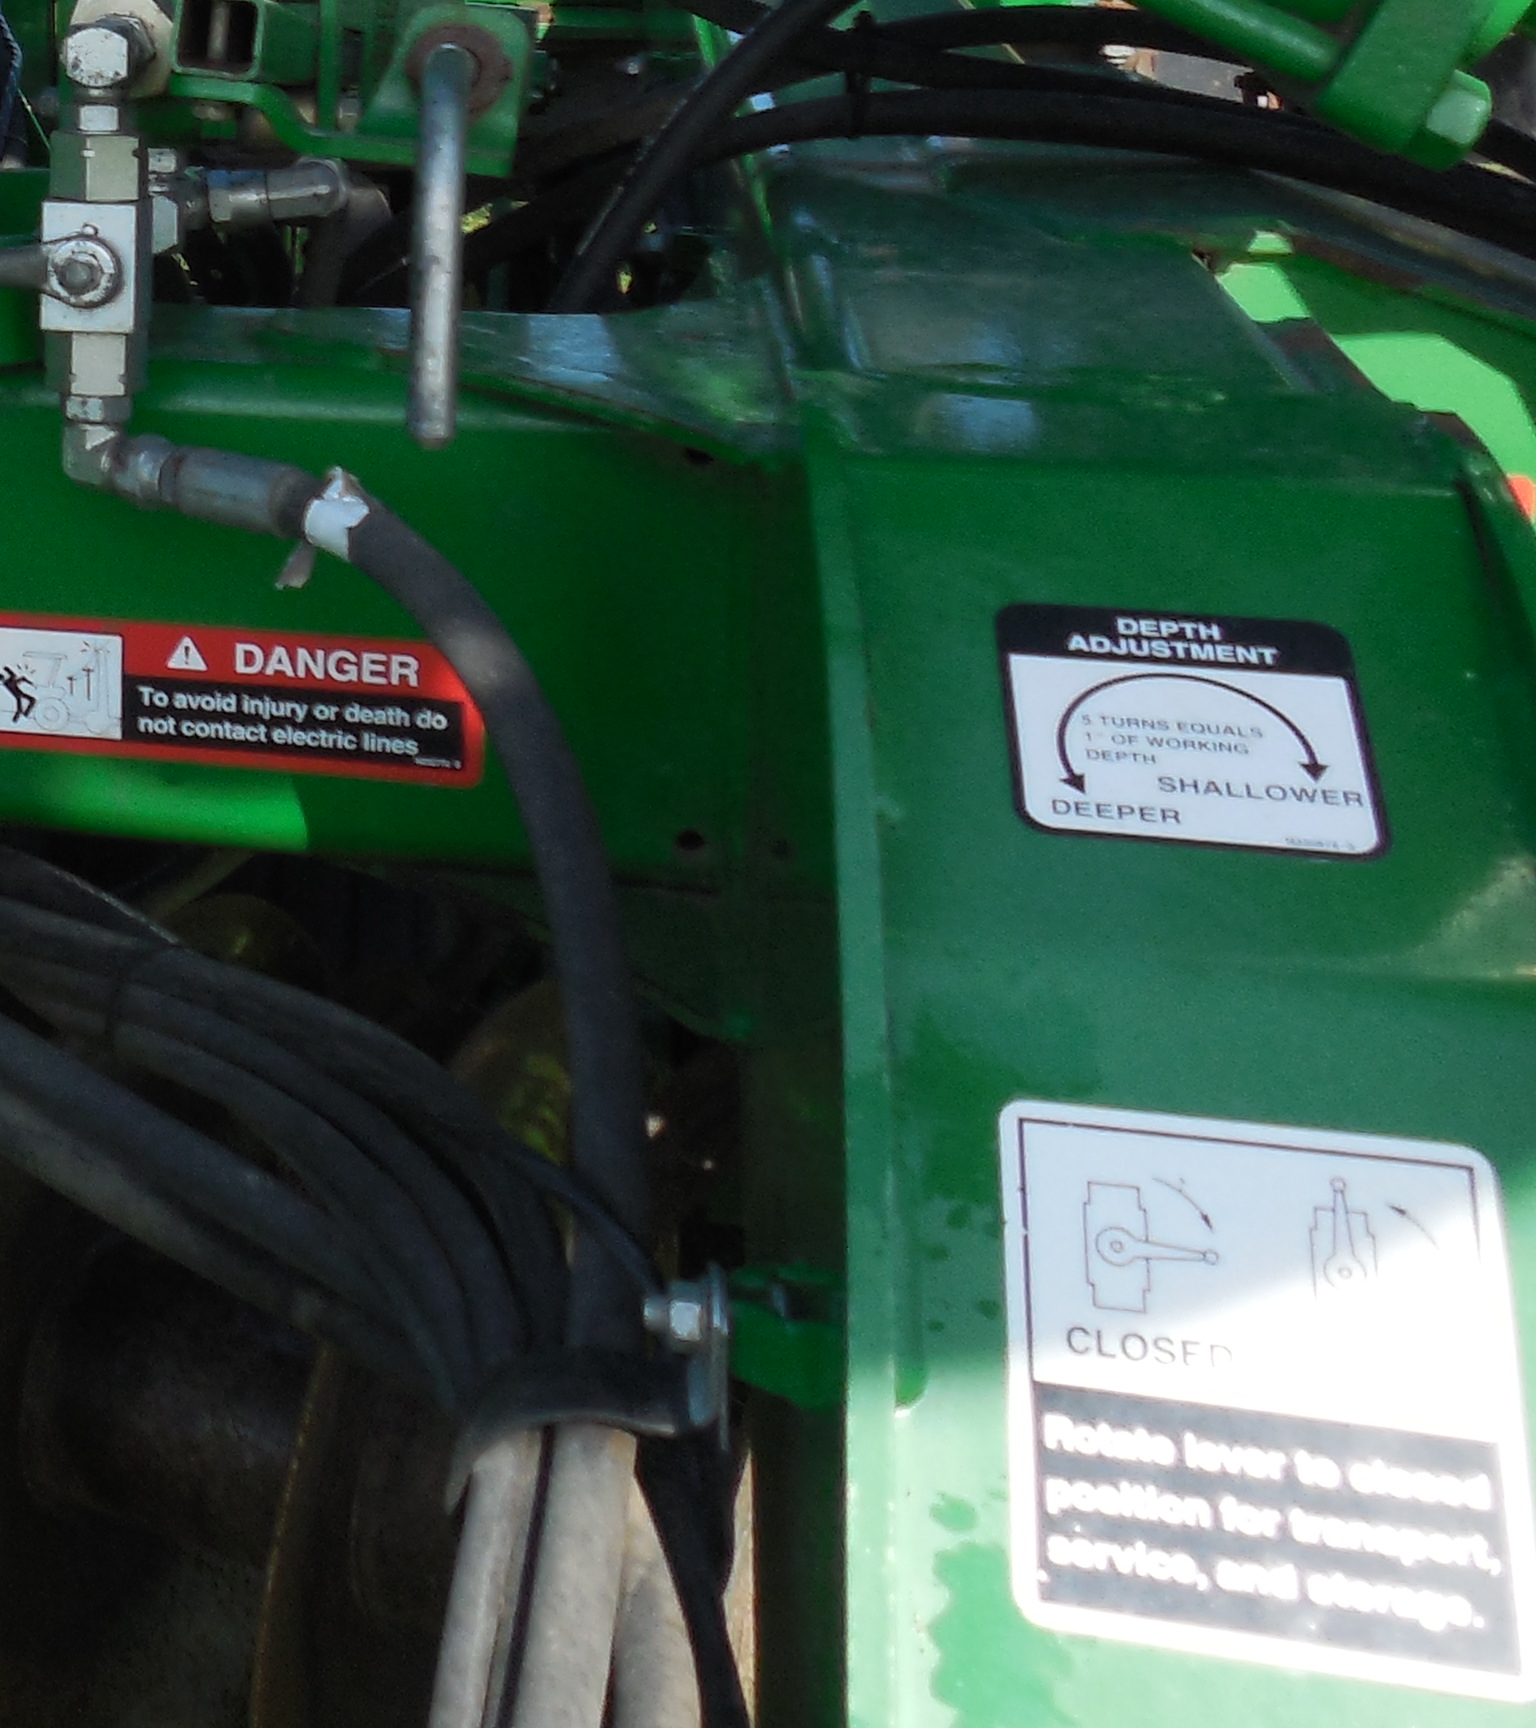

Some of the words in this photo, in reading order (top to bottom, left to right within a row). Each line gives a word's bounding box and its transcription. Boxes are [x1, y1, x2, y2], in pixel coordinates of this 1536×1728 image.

[1115, 616, 1222, 641] DEPTH
[1067, 632, 1280, 665] ADJUSTMENT
[235, 642, 419, 687] DANGER
[137, 685, 169, 707] To
[173, 690, 237, 713] avoid
[241, 693, 308, 722] injury
[313, 704, 339, 721] or
[344, 702, 411, 727] death
[416, 709, 448, 730] do
[137, 715, 177, 736] not
[180, 718, 268, 743] contact
[272, 725, 357, 750] electric
[362, 731, 419, 755] lines
[1099, 715, 1170, 732] TURNS
[1177, 721, 1264, 739] EQUALS
[1085, 748, 1157, 765] DEPTH
[1111, 734, 1140, 746] OF
[1146, 736, 1250, 755] WORKING
[1157, 775, 1364, 807] SHALLOWER
[1051, 798, 1183, 825] DEEPER
